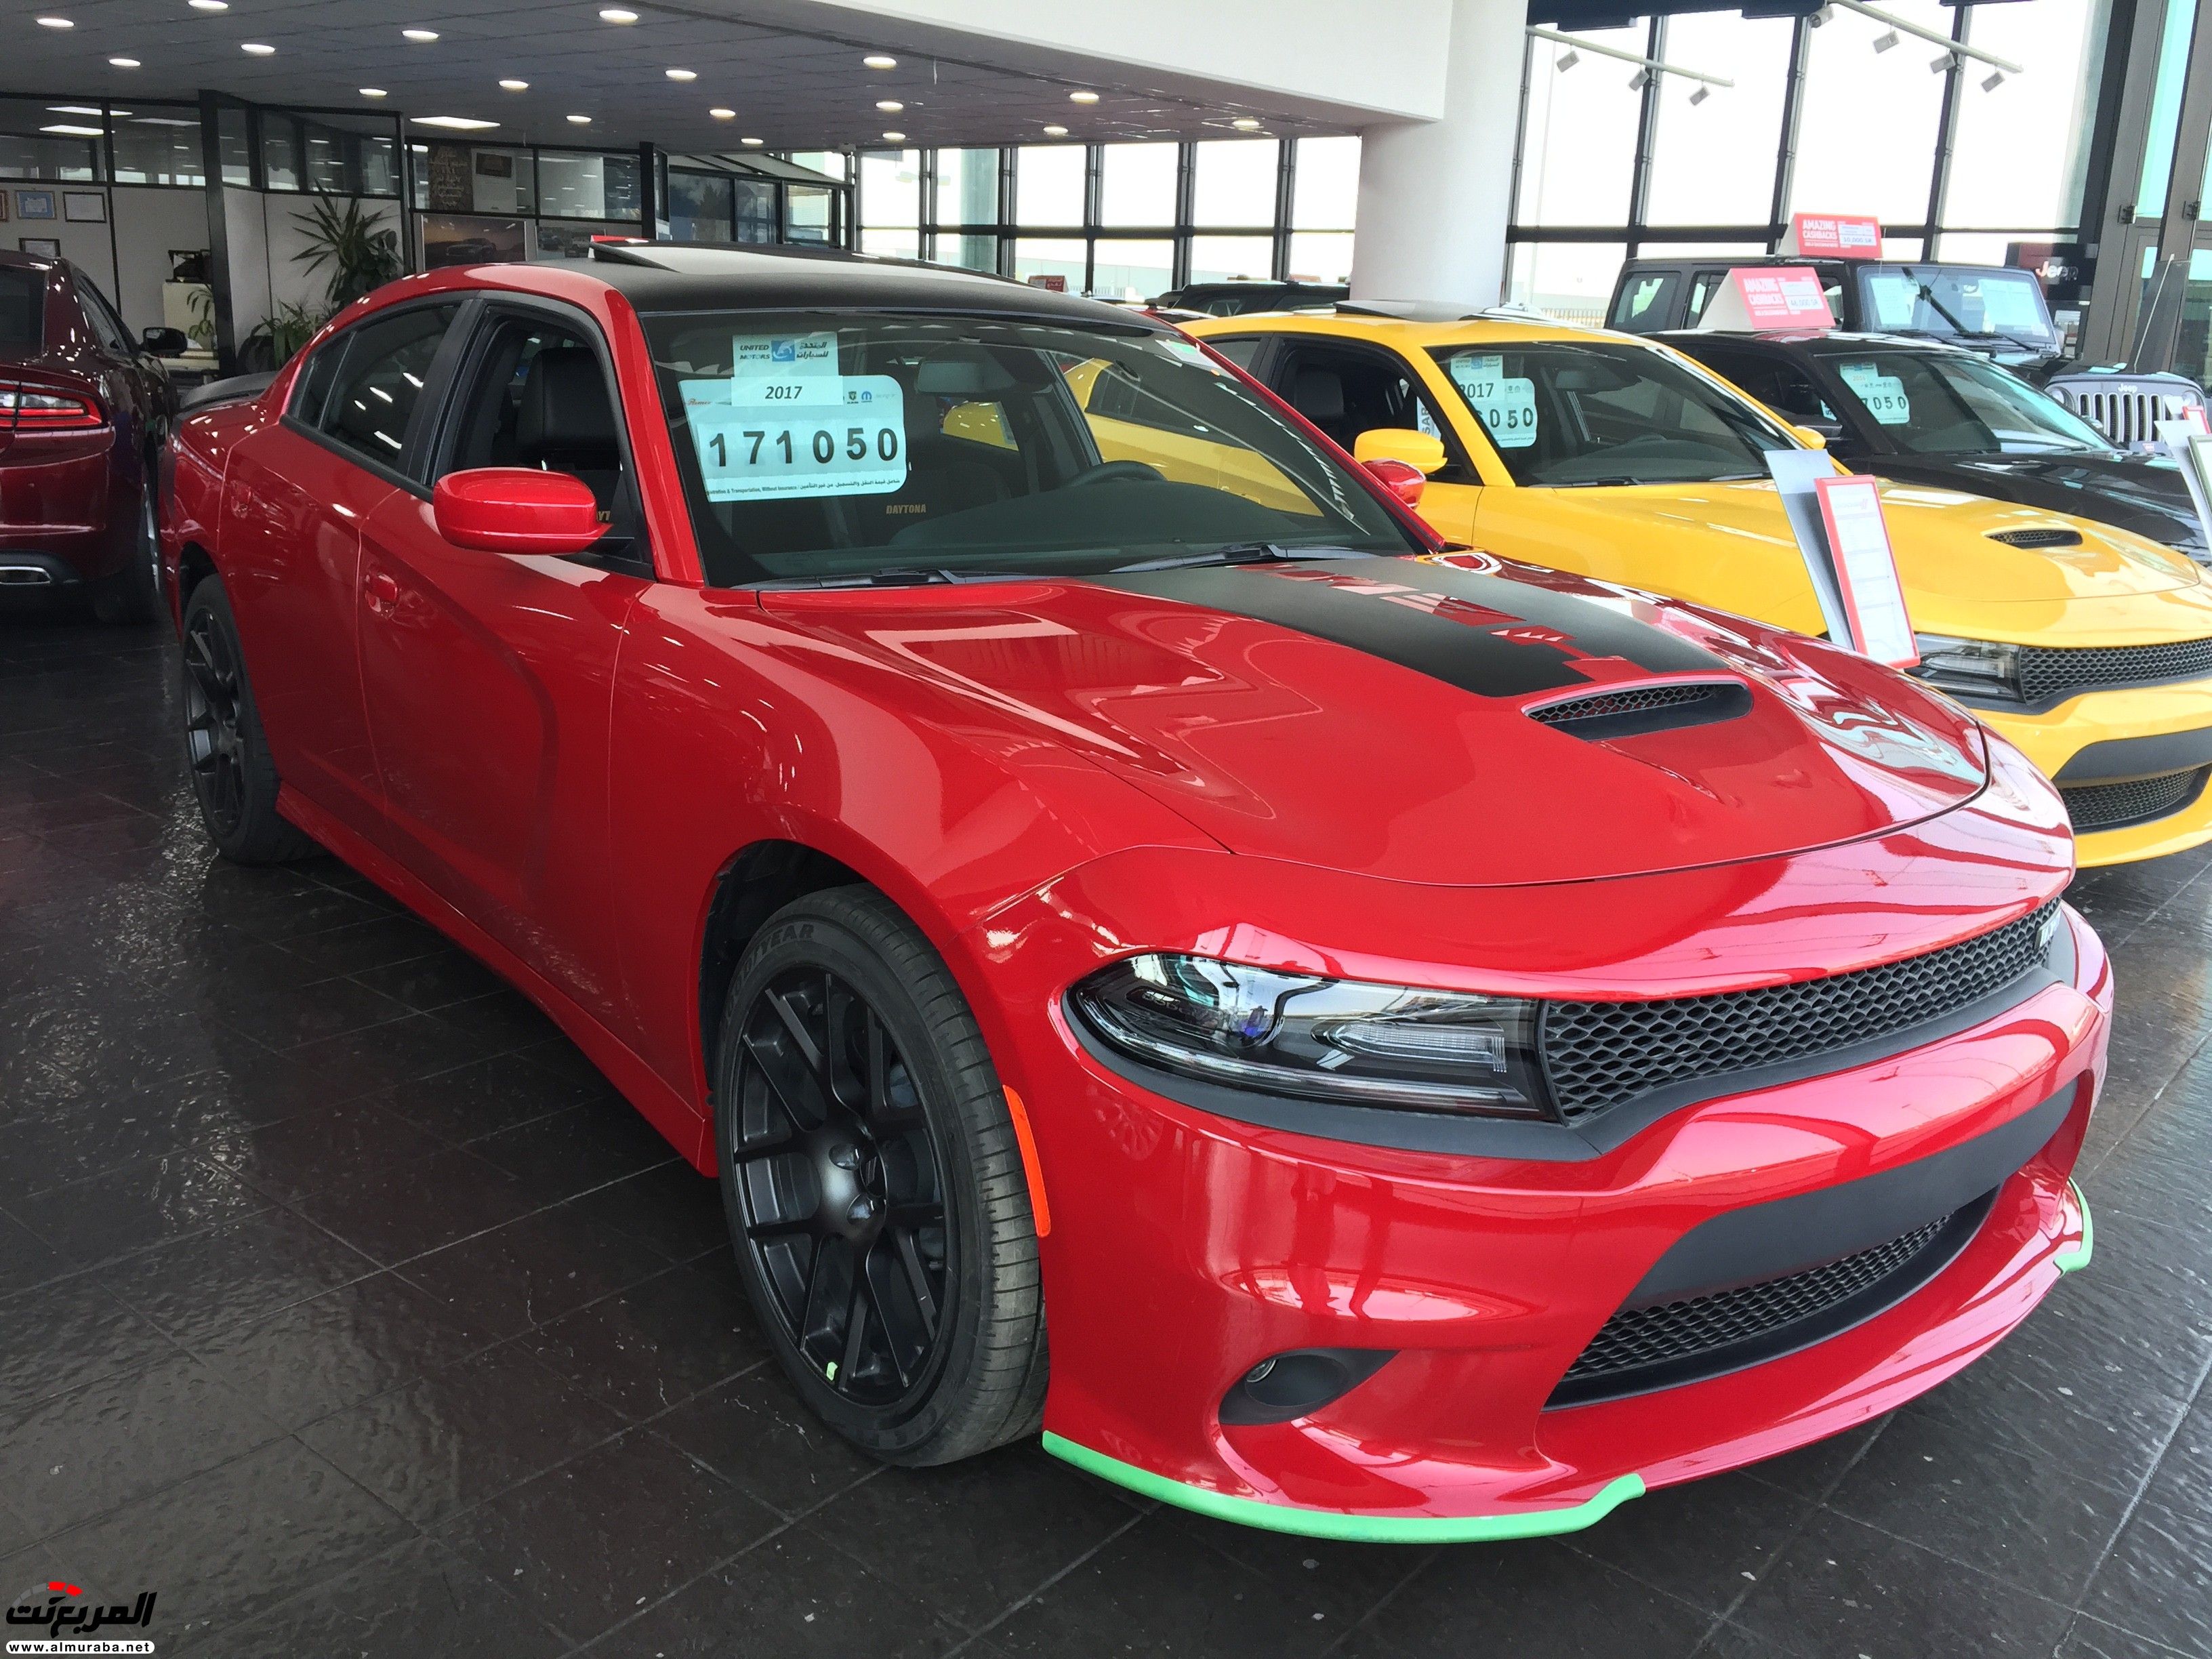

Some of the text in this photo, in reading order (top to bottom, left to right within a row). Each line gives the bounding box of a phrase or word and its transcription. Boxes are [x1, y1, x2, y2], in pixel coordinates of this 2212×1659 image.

[1803, 219, 1836, 230] AMAZING
[1803, 230, 1837, 239] CASHBACKS
[800, 341, 827, 350] المتحدة
[796, 350, 829, 360] للسيارات
[764, 386, 802, 399] 2017
[2118, 383, 2137, 393] Jeep
[1477, 407, 1534, 428] 050
[709, 427, 898, 468] 171050
[886, 504, 926, 514] DAYTONA
